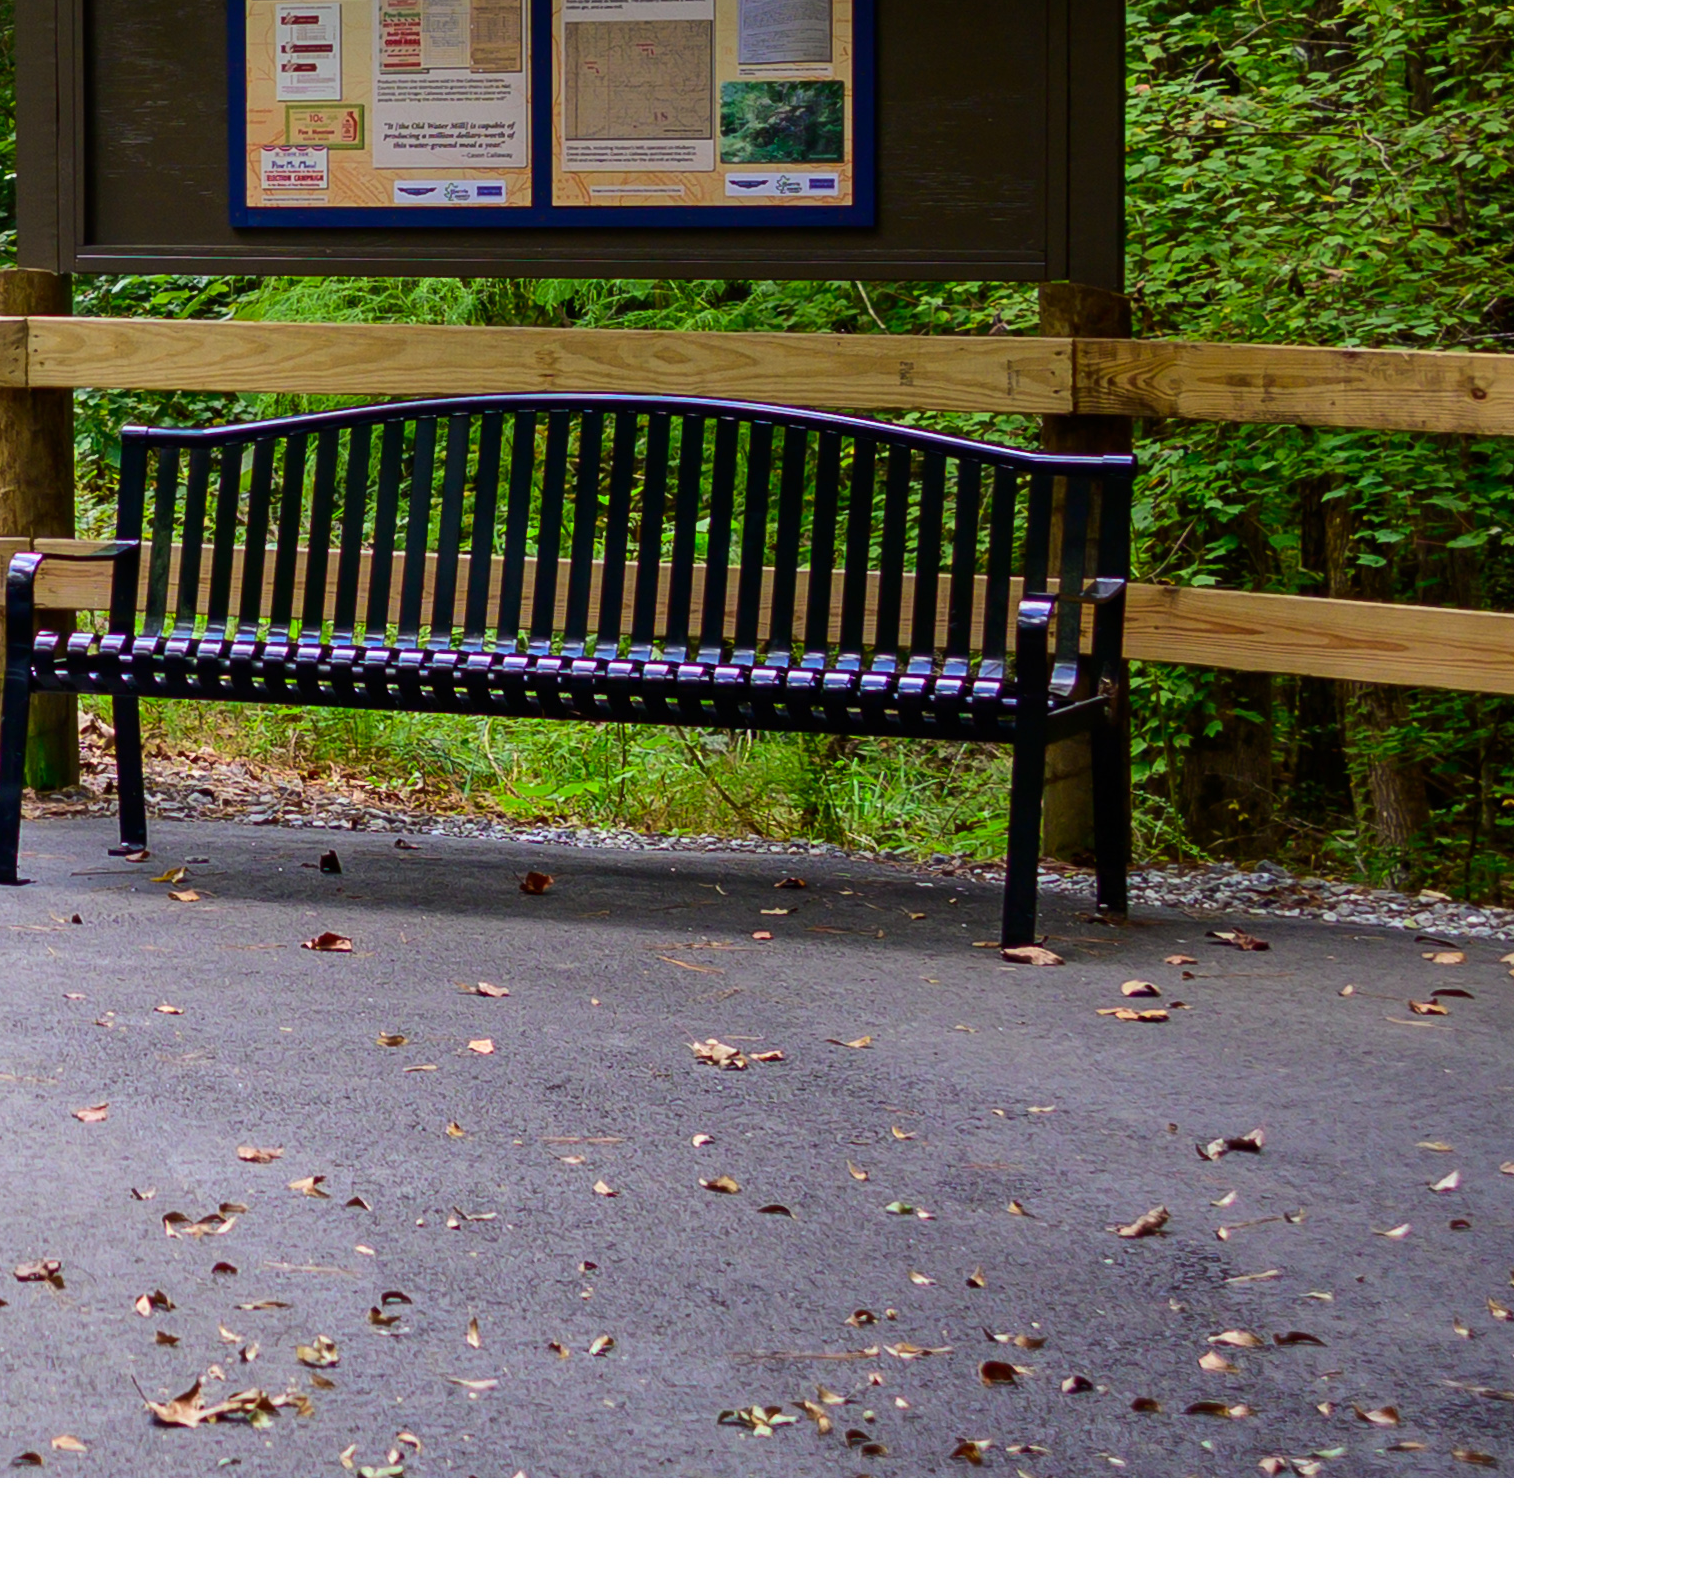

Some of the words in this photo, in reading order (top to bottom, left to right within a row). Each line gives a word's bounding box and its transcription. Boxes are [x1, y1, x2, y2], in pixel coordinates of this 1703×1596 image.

[411, 122, 425, 130] Old
[428, 122, 449, 130] Water
[478, 121, 505, 131] capable
[383, 132, 420, 141] producing
[428, 131, 454, 139] million
